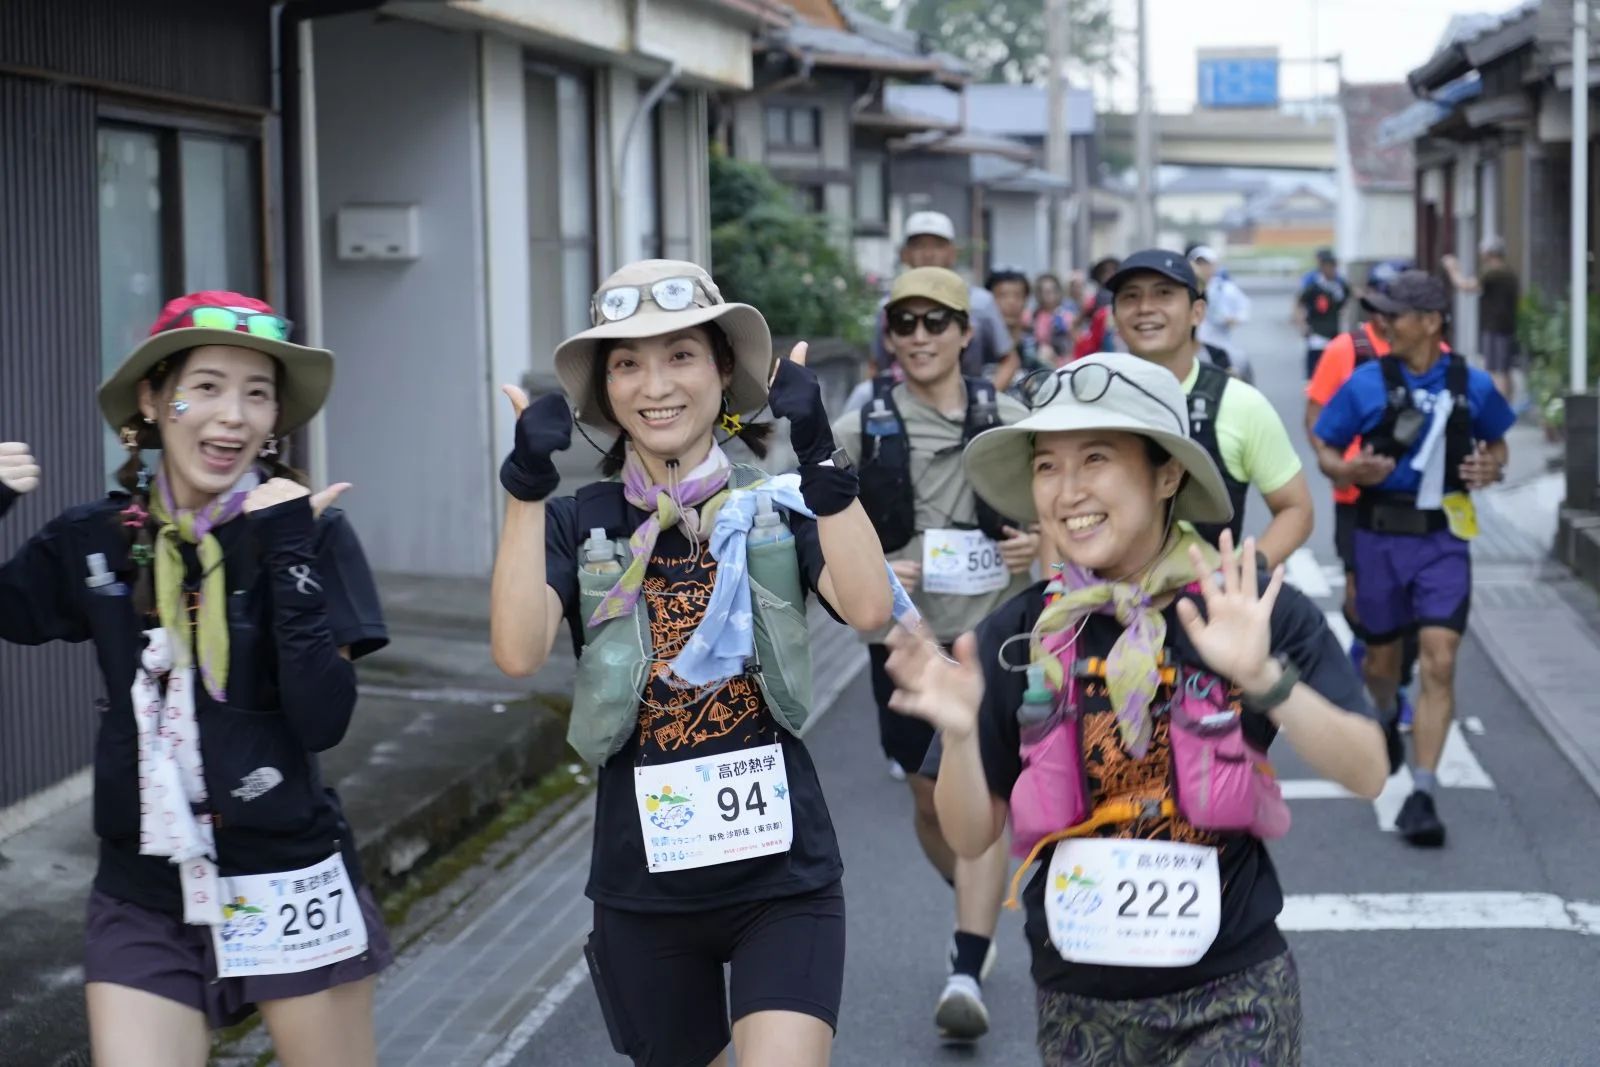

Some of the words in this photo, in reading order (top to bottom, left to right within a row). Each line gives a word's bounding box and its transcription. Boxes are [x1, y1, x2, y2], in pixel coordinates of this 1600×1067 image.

[717, 755, 776, 780] 高砂熱学
[717, 781, 768, 822] 94
[279, 888, 343, 936] 267
[1116, 879, 1201, 918] 222
